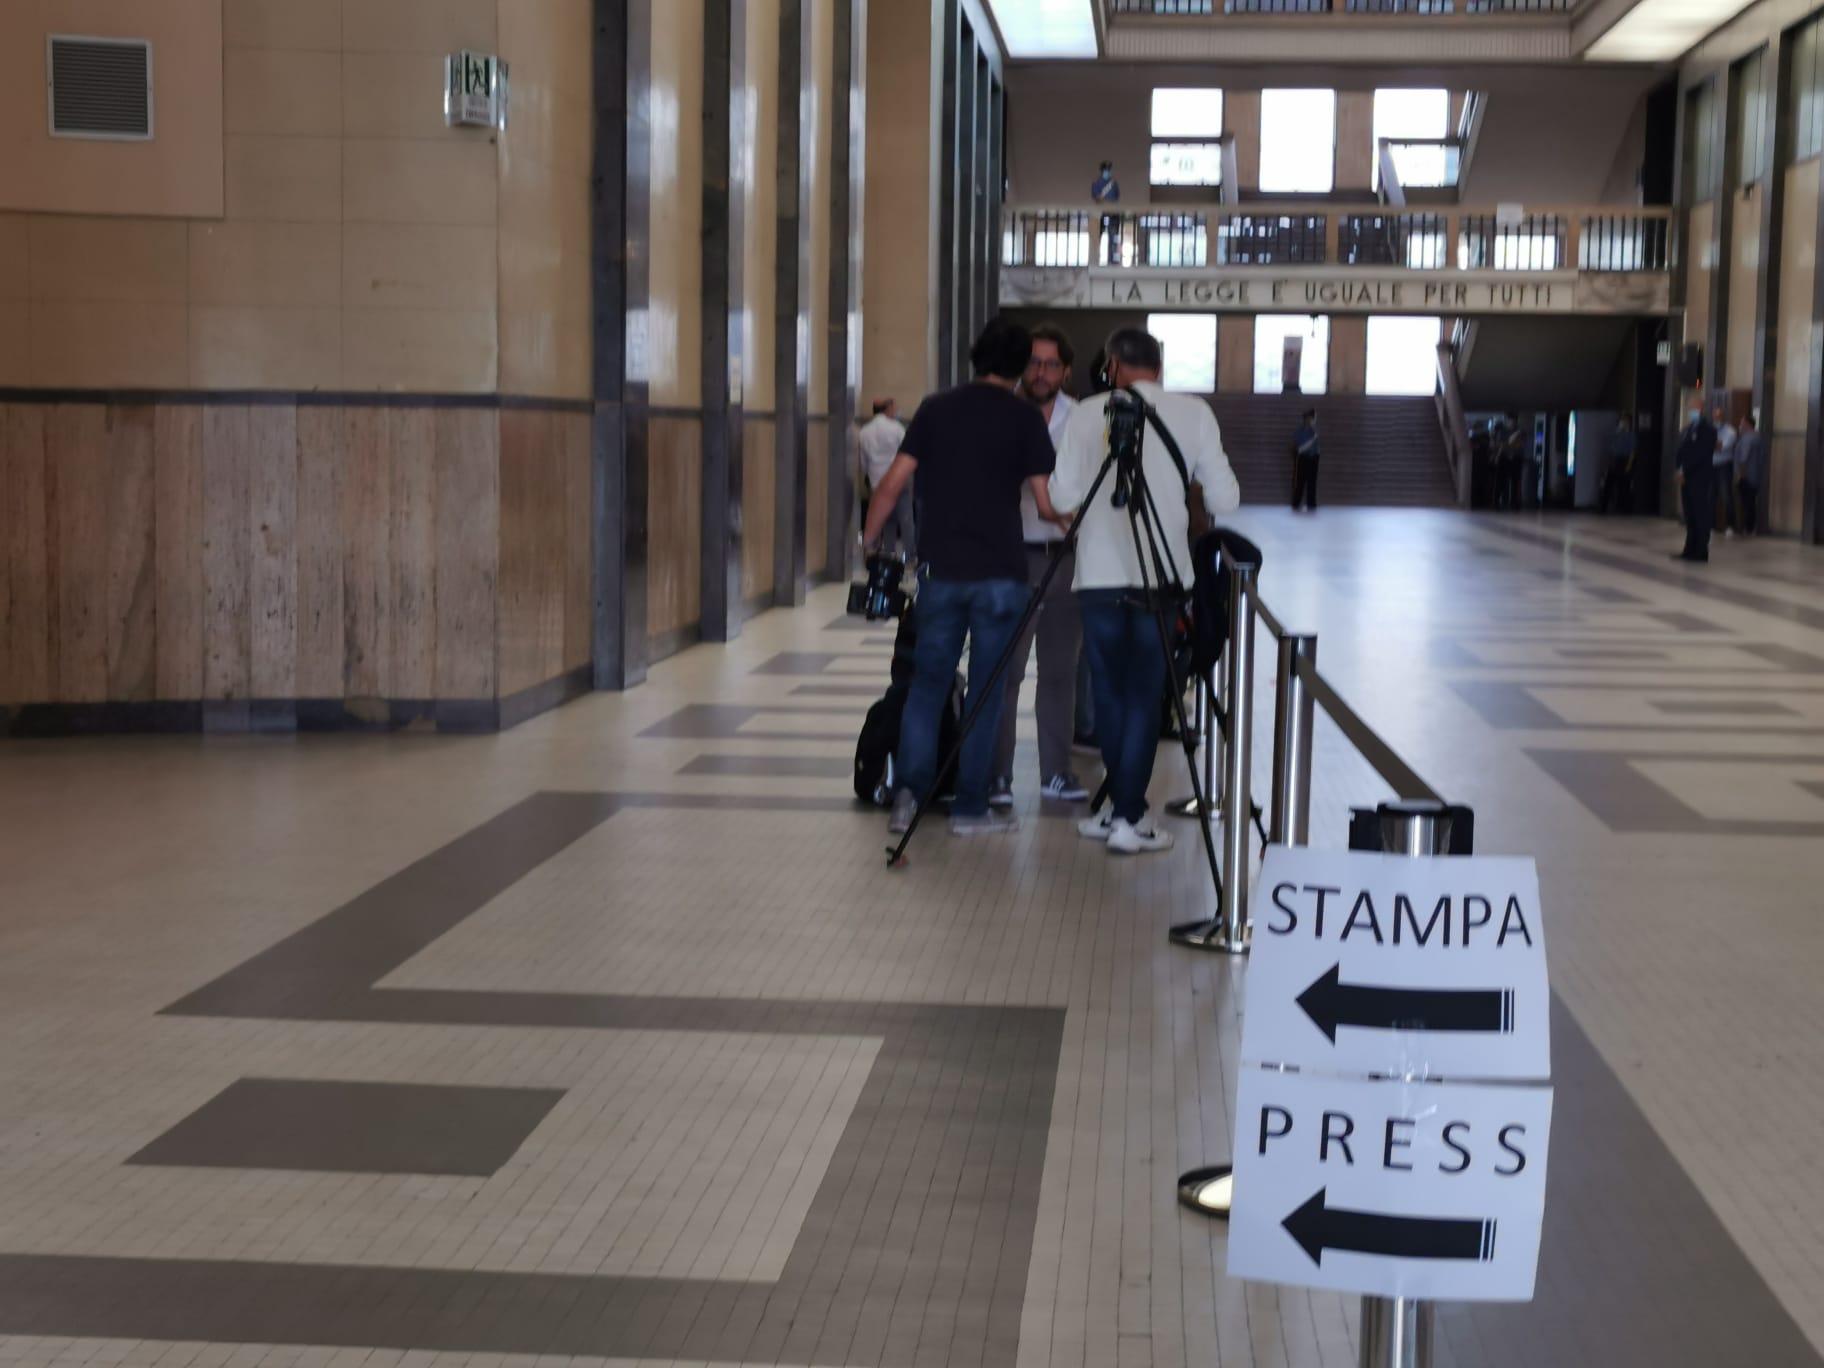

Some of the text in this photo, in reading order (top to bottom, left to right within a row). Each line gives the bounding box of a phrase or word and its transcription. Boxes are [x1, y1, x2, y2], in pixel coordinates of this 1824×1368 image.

[1111, 279, 1143, 304] LA
[1164, 279, 1250, 305] LEGGE
[1304, 280, 1403, 305] UGUALE
[1424, 280, 1468, 306] PER
[1487, 281, 1551, 306] TUTTI
[1267, 881, 1533, 948] STAMPA
[1258, 1104, 1527, 1176] PRESS
